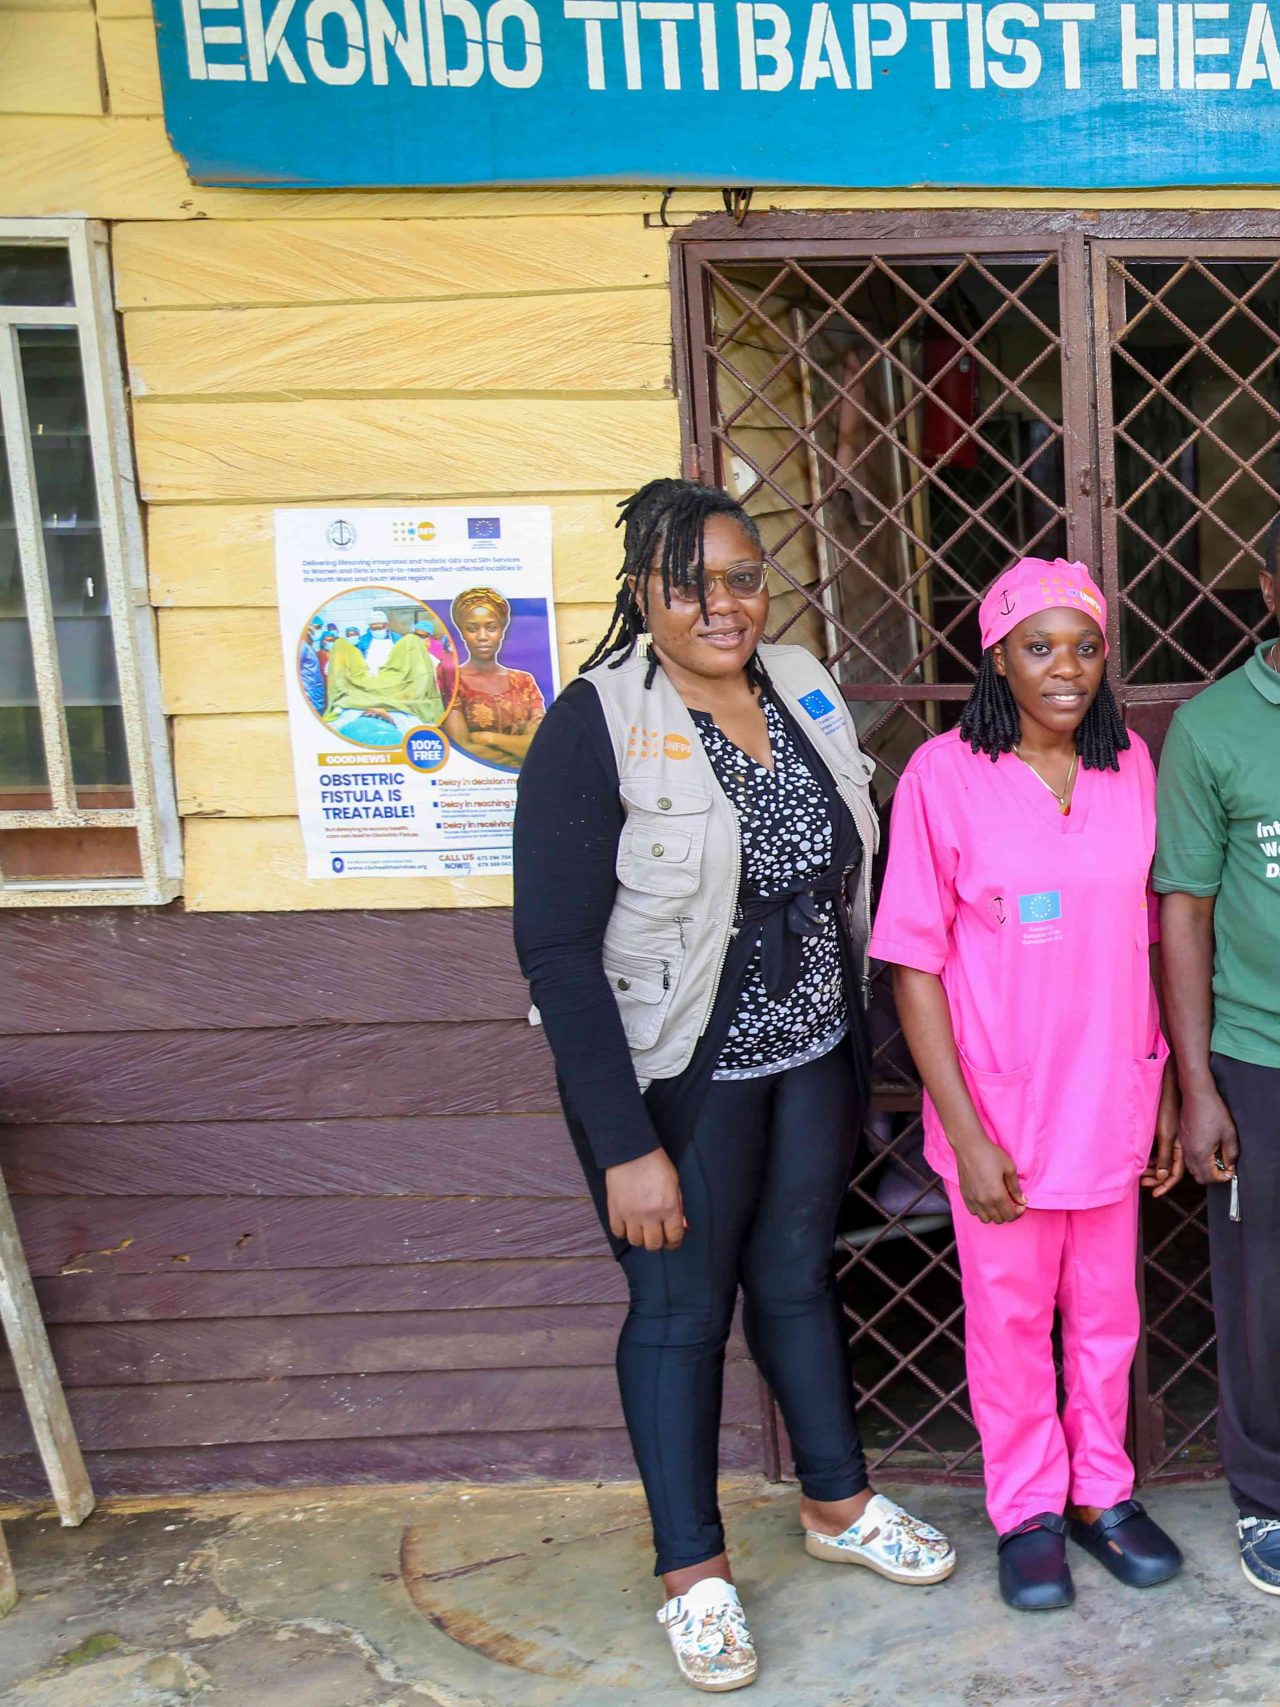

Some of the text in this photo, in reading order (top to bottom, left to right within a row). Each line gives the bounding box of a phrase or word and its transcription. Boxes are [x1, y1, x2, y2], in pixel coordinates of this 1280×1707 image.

[184, 0, 542, 88] EKONDO
[563, 1, 719, 90] TITI
[736, 1, 1095, 90] BAPTIST
[410, 740, 443, 761] 100% FREE
[326, 755, 356, 764] GOOD
[320, 773, 404, 786] OBSTETRIC
[439, 779, 461, 787] Delay
[321, 789, 401, 803] FISTULA IS
[440, 801, 463, 809] Delay
[474, 800, 510, 808] reaching
[322, 805, 415, 819] TREATABLE!
[443, 822, 466, 830] Delay
